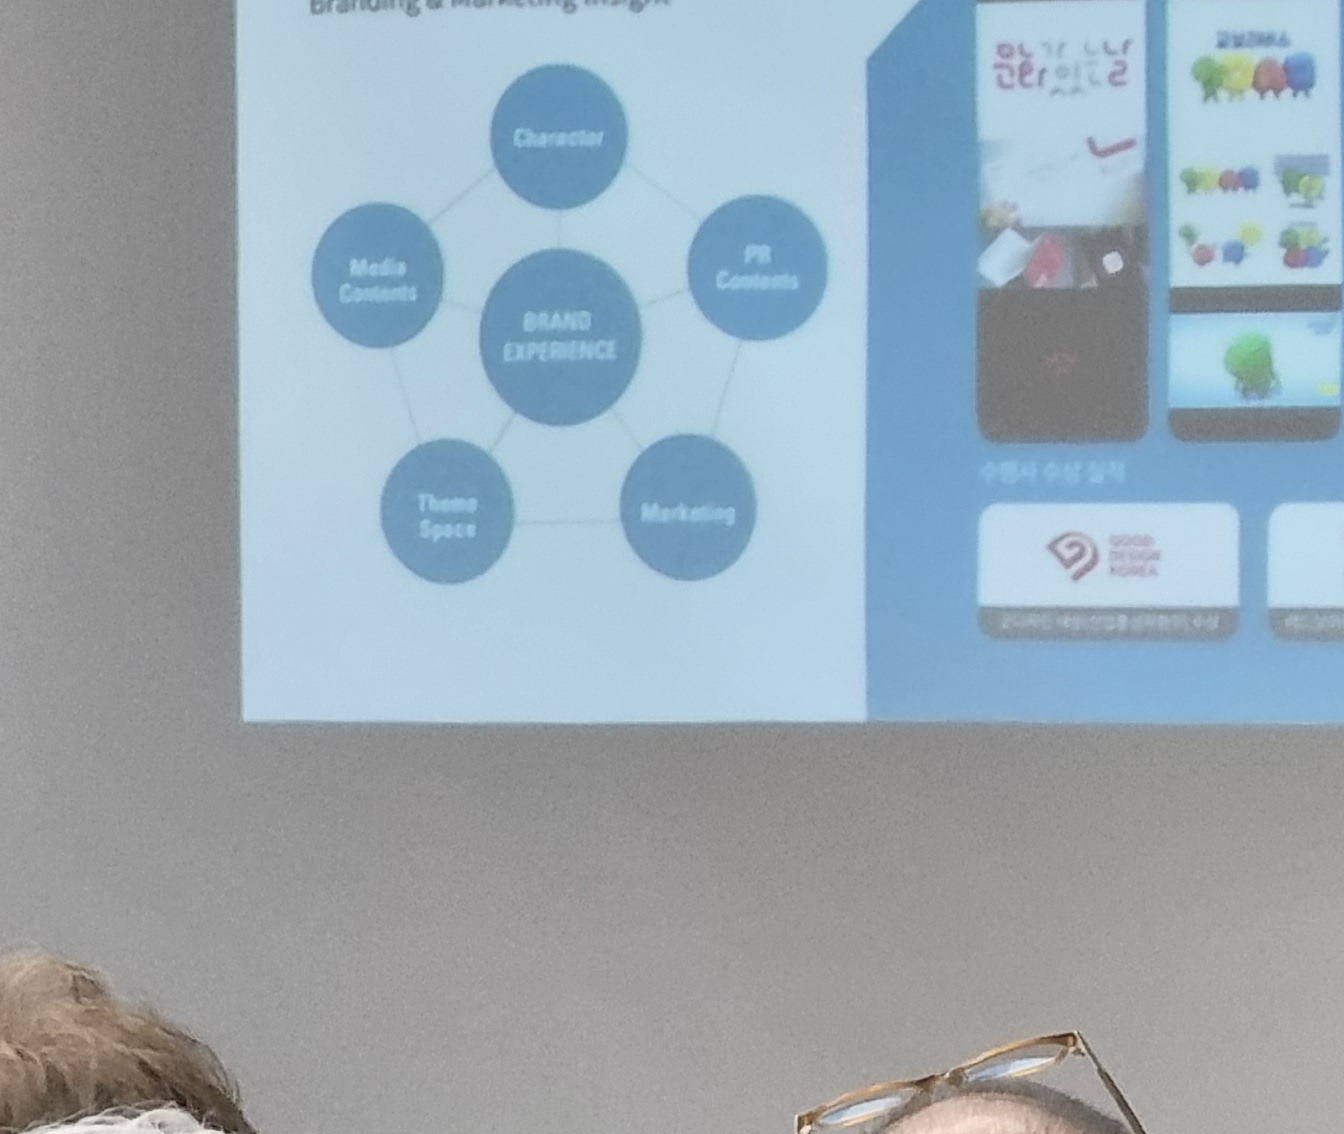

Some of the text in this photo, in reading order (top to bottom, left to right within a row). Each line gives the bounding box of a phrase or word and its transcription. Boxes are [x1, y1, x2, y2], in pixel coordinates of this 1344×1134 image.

[744, 244, 771, 264] PR
[350, 257, 407, 277] Media
[523, 310, 591, 332] BRAND
[503, 339, 617, 362] EXPERIENCE
[418, 493, 479, 512] Theme
[640, 502, 737, 527] Marketing
[419, 519, 477, 541] Space
